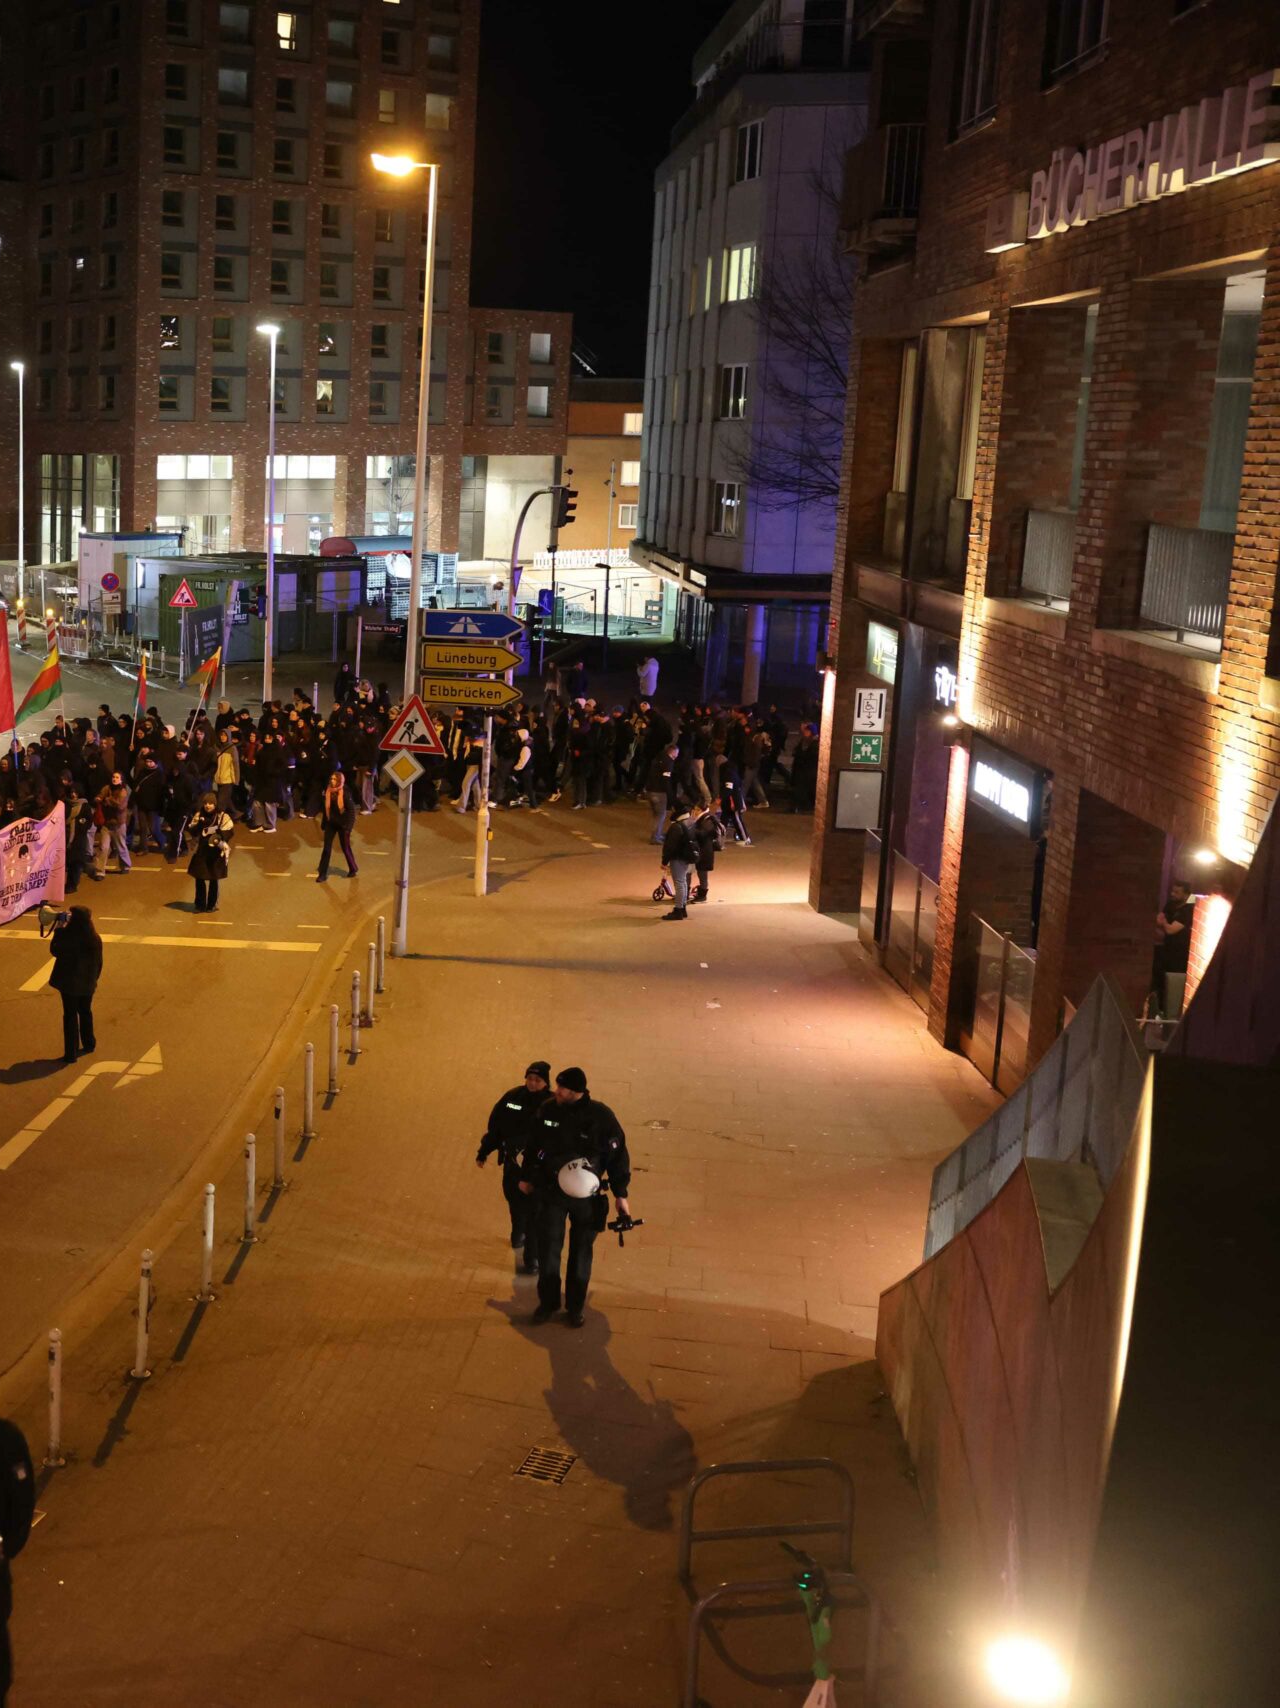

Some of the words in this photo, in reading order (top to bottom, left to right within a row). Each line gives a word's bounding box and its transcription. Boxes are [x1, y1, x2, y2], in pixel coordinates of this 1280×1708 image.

[1028, 68, 1280, 238] BÜCHERHALLE
[436, 652, 497, 667] Lüneburg
[429, 685, 502, 700] Elbbrücken
